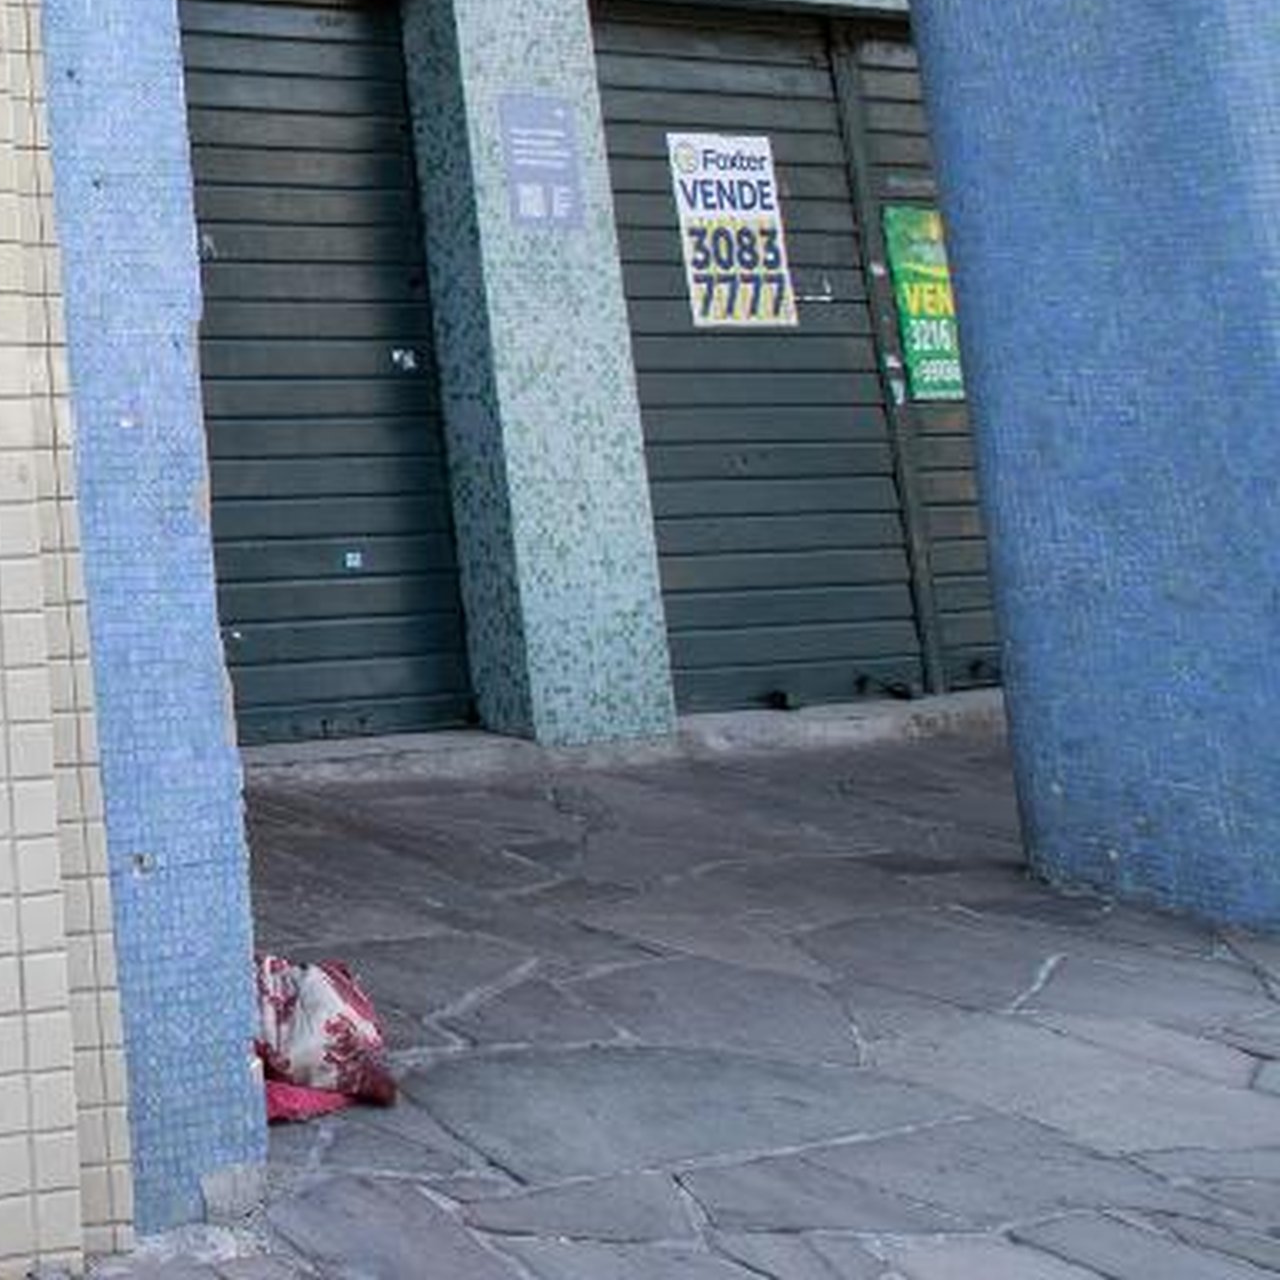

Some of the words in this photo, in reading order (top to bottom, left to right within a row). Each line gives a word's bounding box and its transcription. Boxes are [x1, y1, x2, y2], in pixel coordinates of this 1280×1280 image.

[701, 149, 768, 171] Foxter
[679, 179, 775, 210] VENDE
[688, 227, 782, 270] 3083
[693, 273, 786, 318] 7777
